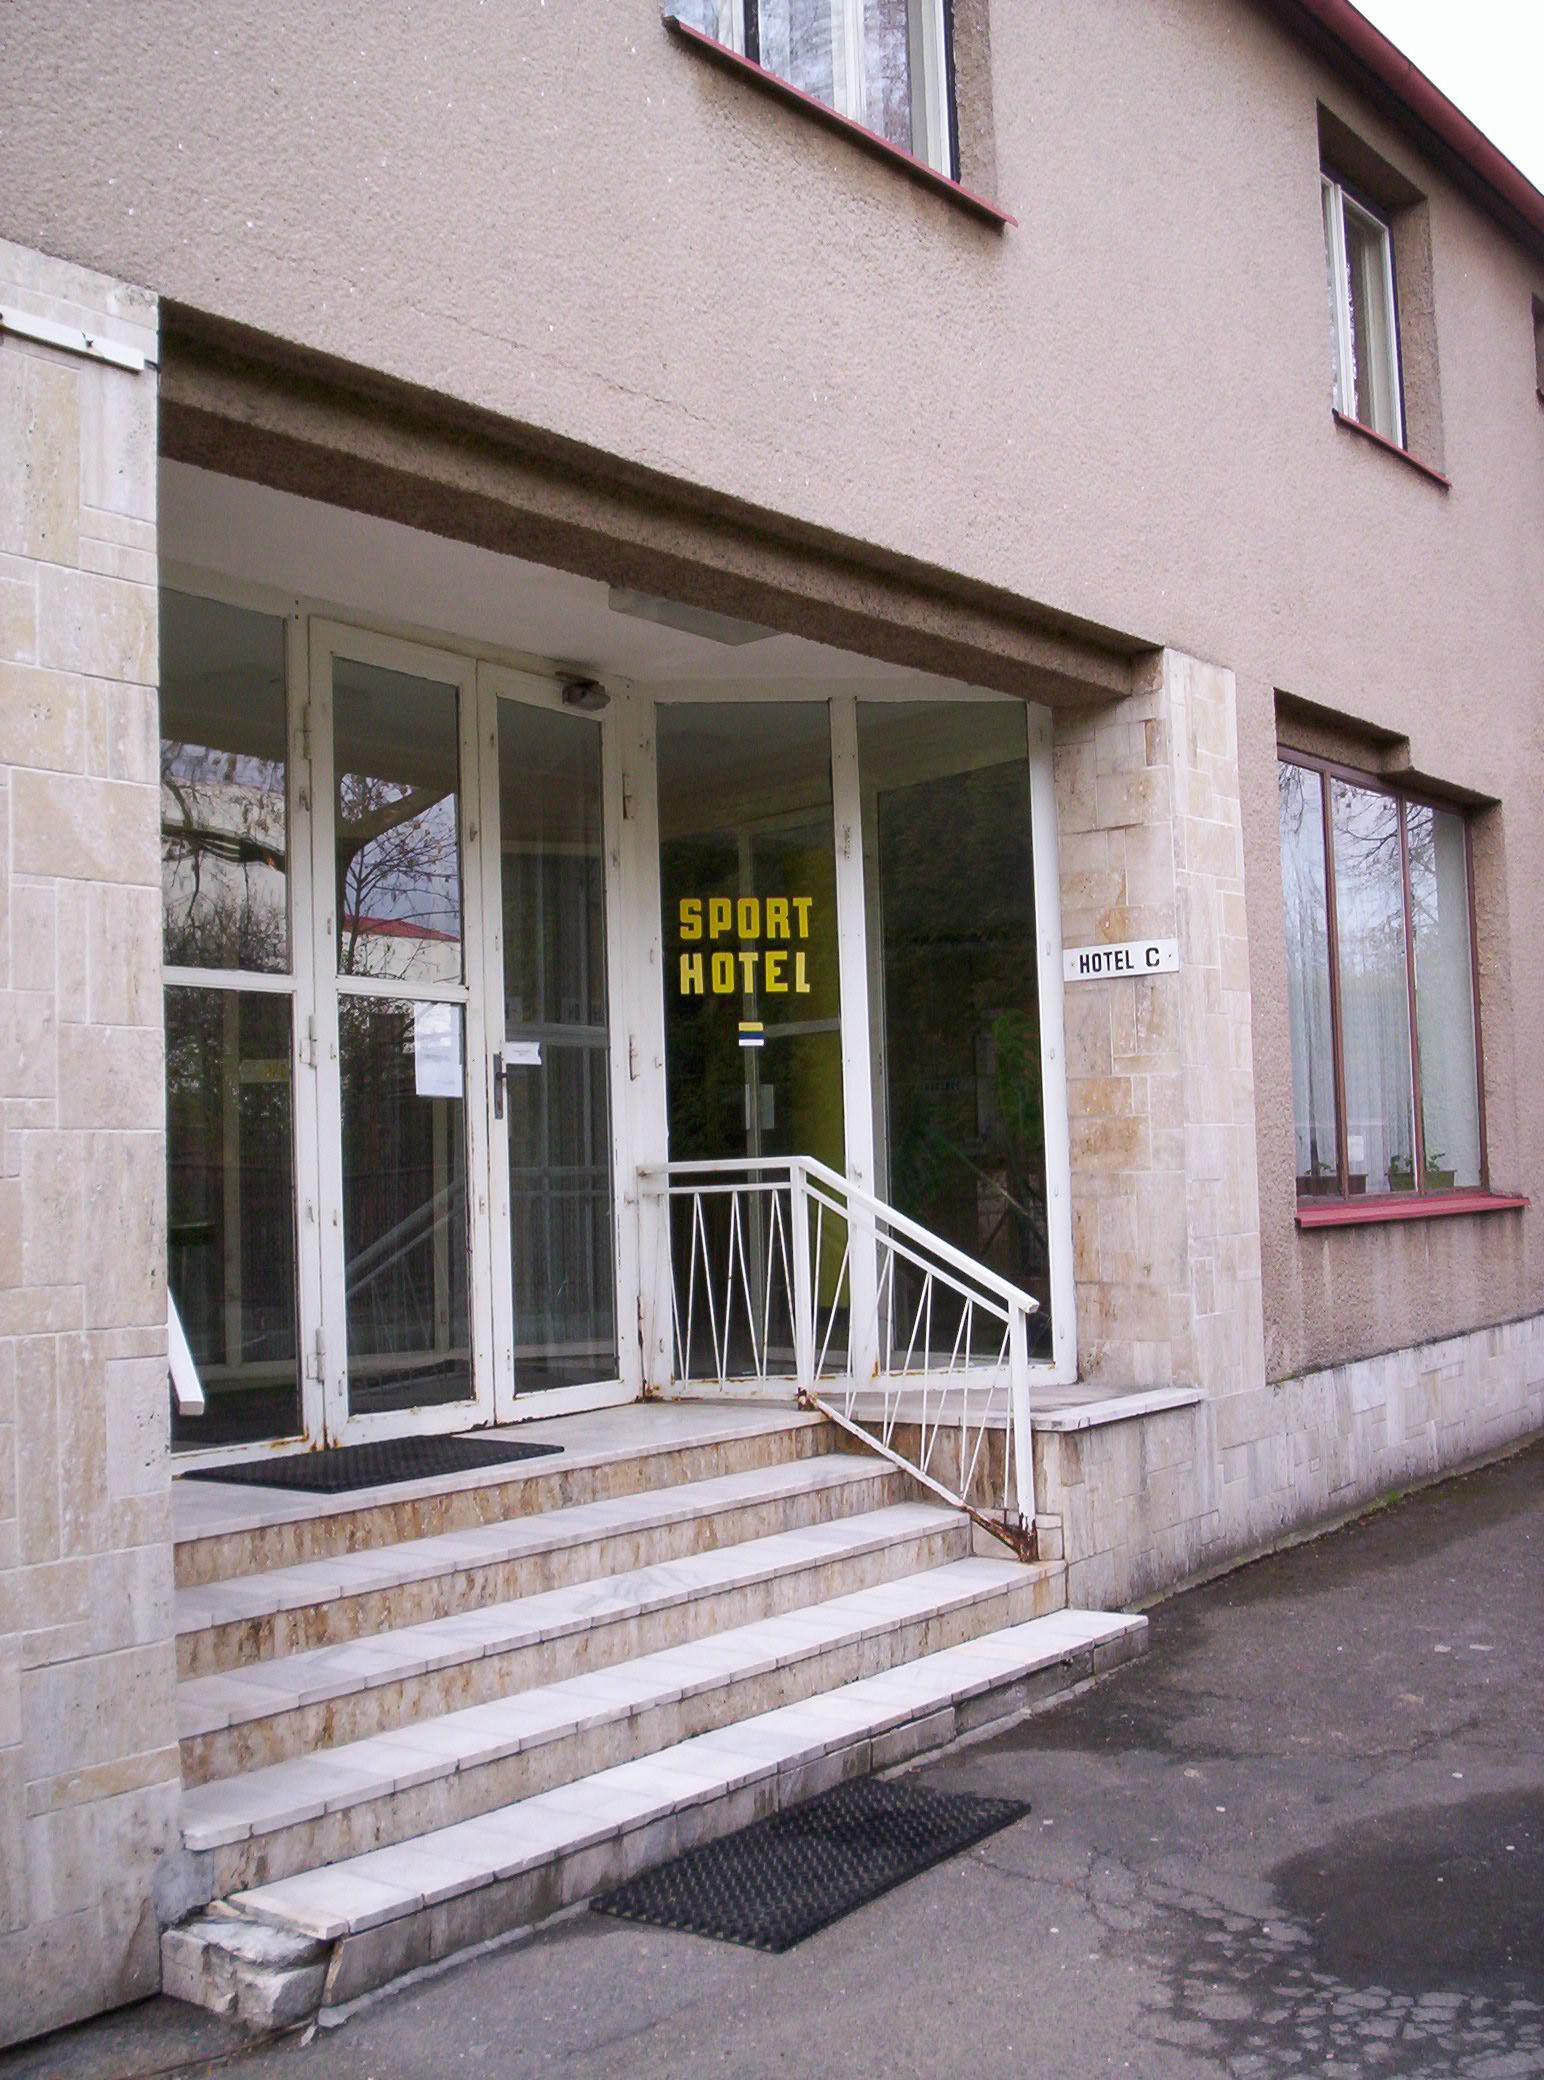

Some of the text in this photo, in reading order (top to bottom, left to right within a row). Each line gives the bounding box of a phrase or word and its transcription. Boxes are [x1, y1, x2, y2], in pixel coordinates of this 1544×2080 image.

[680, 897, 813, 939] SPORT
[680, 951, 811, 995] HOTEL
[1079, 947, 1160, 974] HOTEL C
